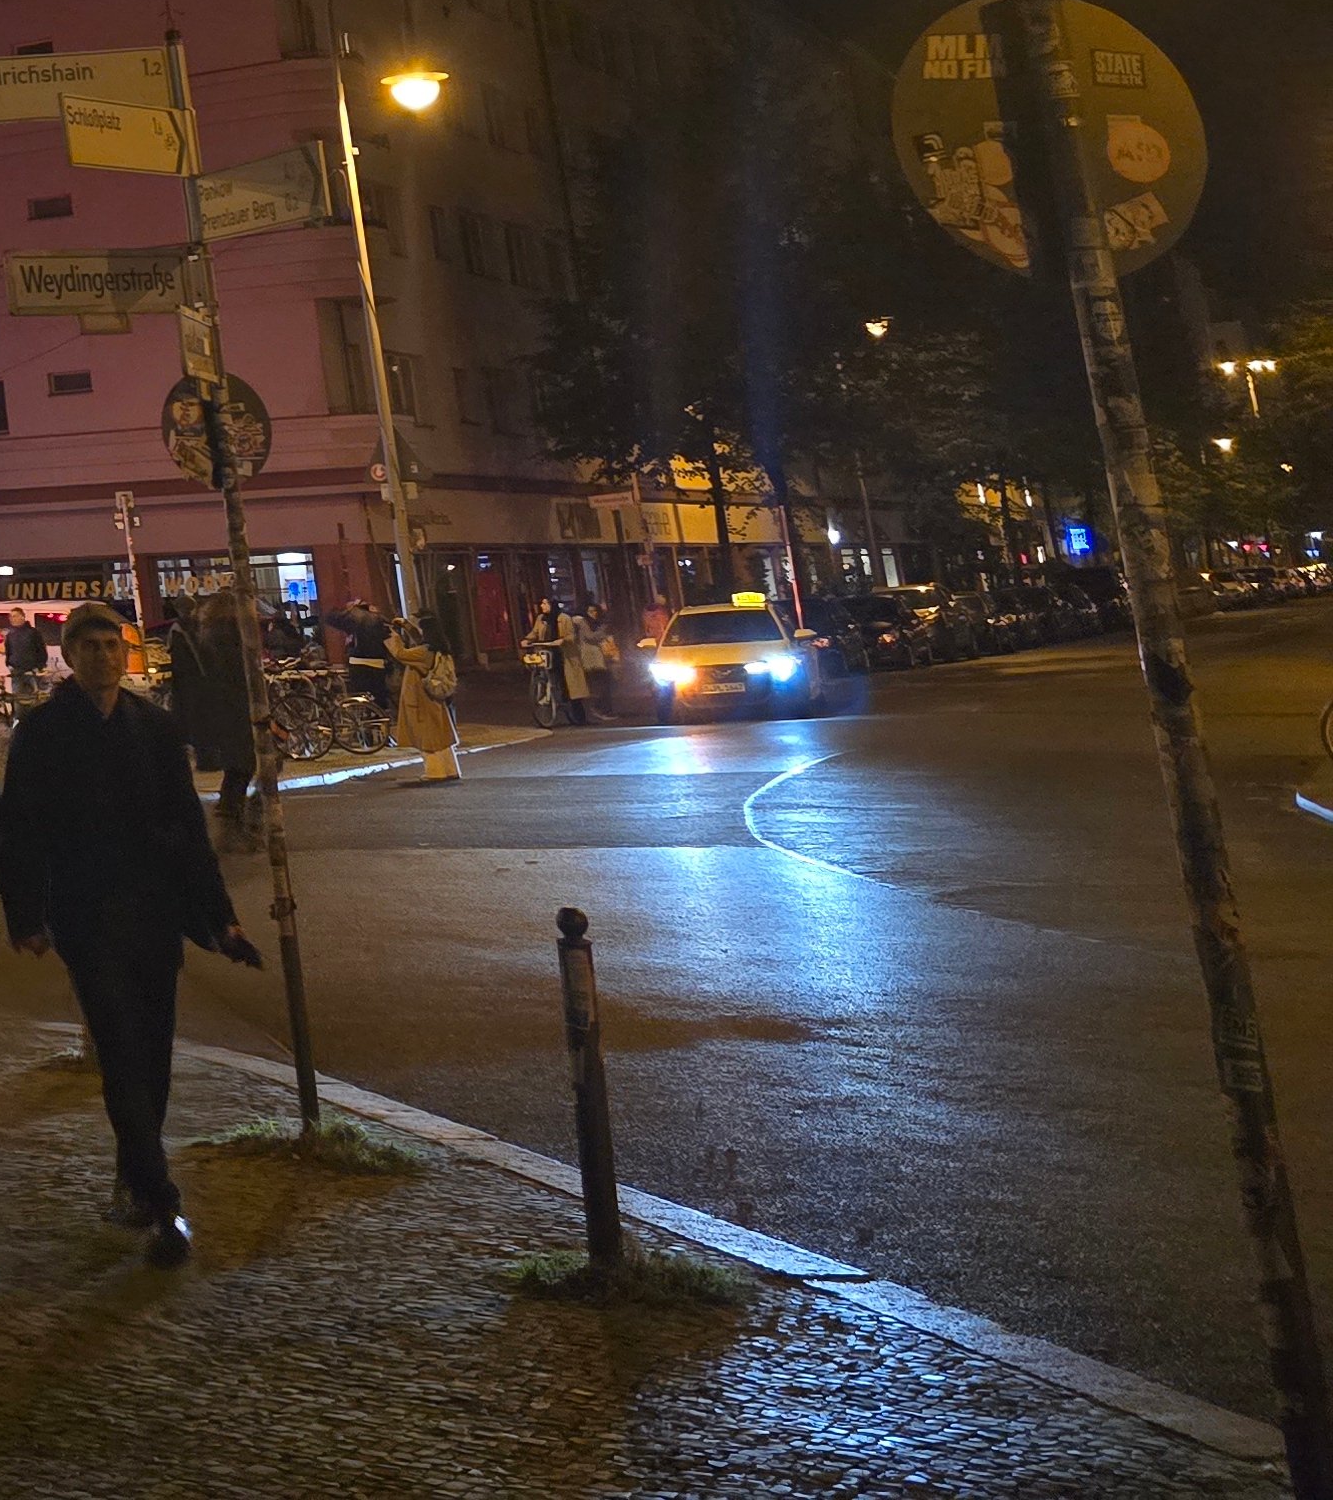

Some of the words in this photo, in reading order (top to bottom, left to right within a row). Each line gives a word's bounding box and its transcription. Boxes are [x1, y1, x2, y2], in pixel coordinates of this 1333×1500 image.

[1094, 50, 1141, 75] STATE
[66, 105, 121, 134] Schloßplatz
[252, 201, 277, 222] Berg
[20, 263, 176, 299] Weydingerstraße
[7, 580, 130, 600] UNIVERSAL
